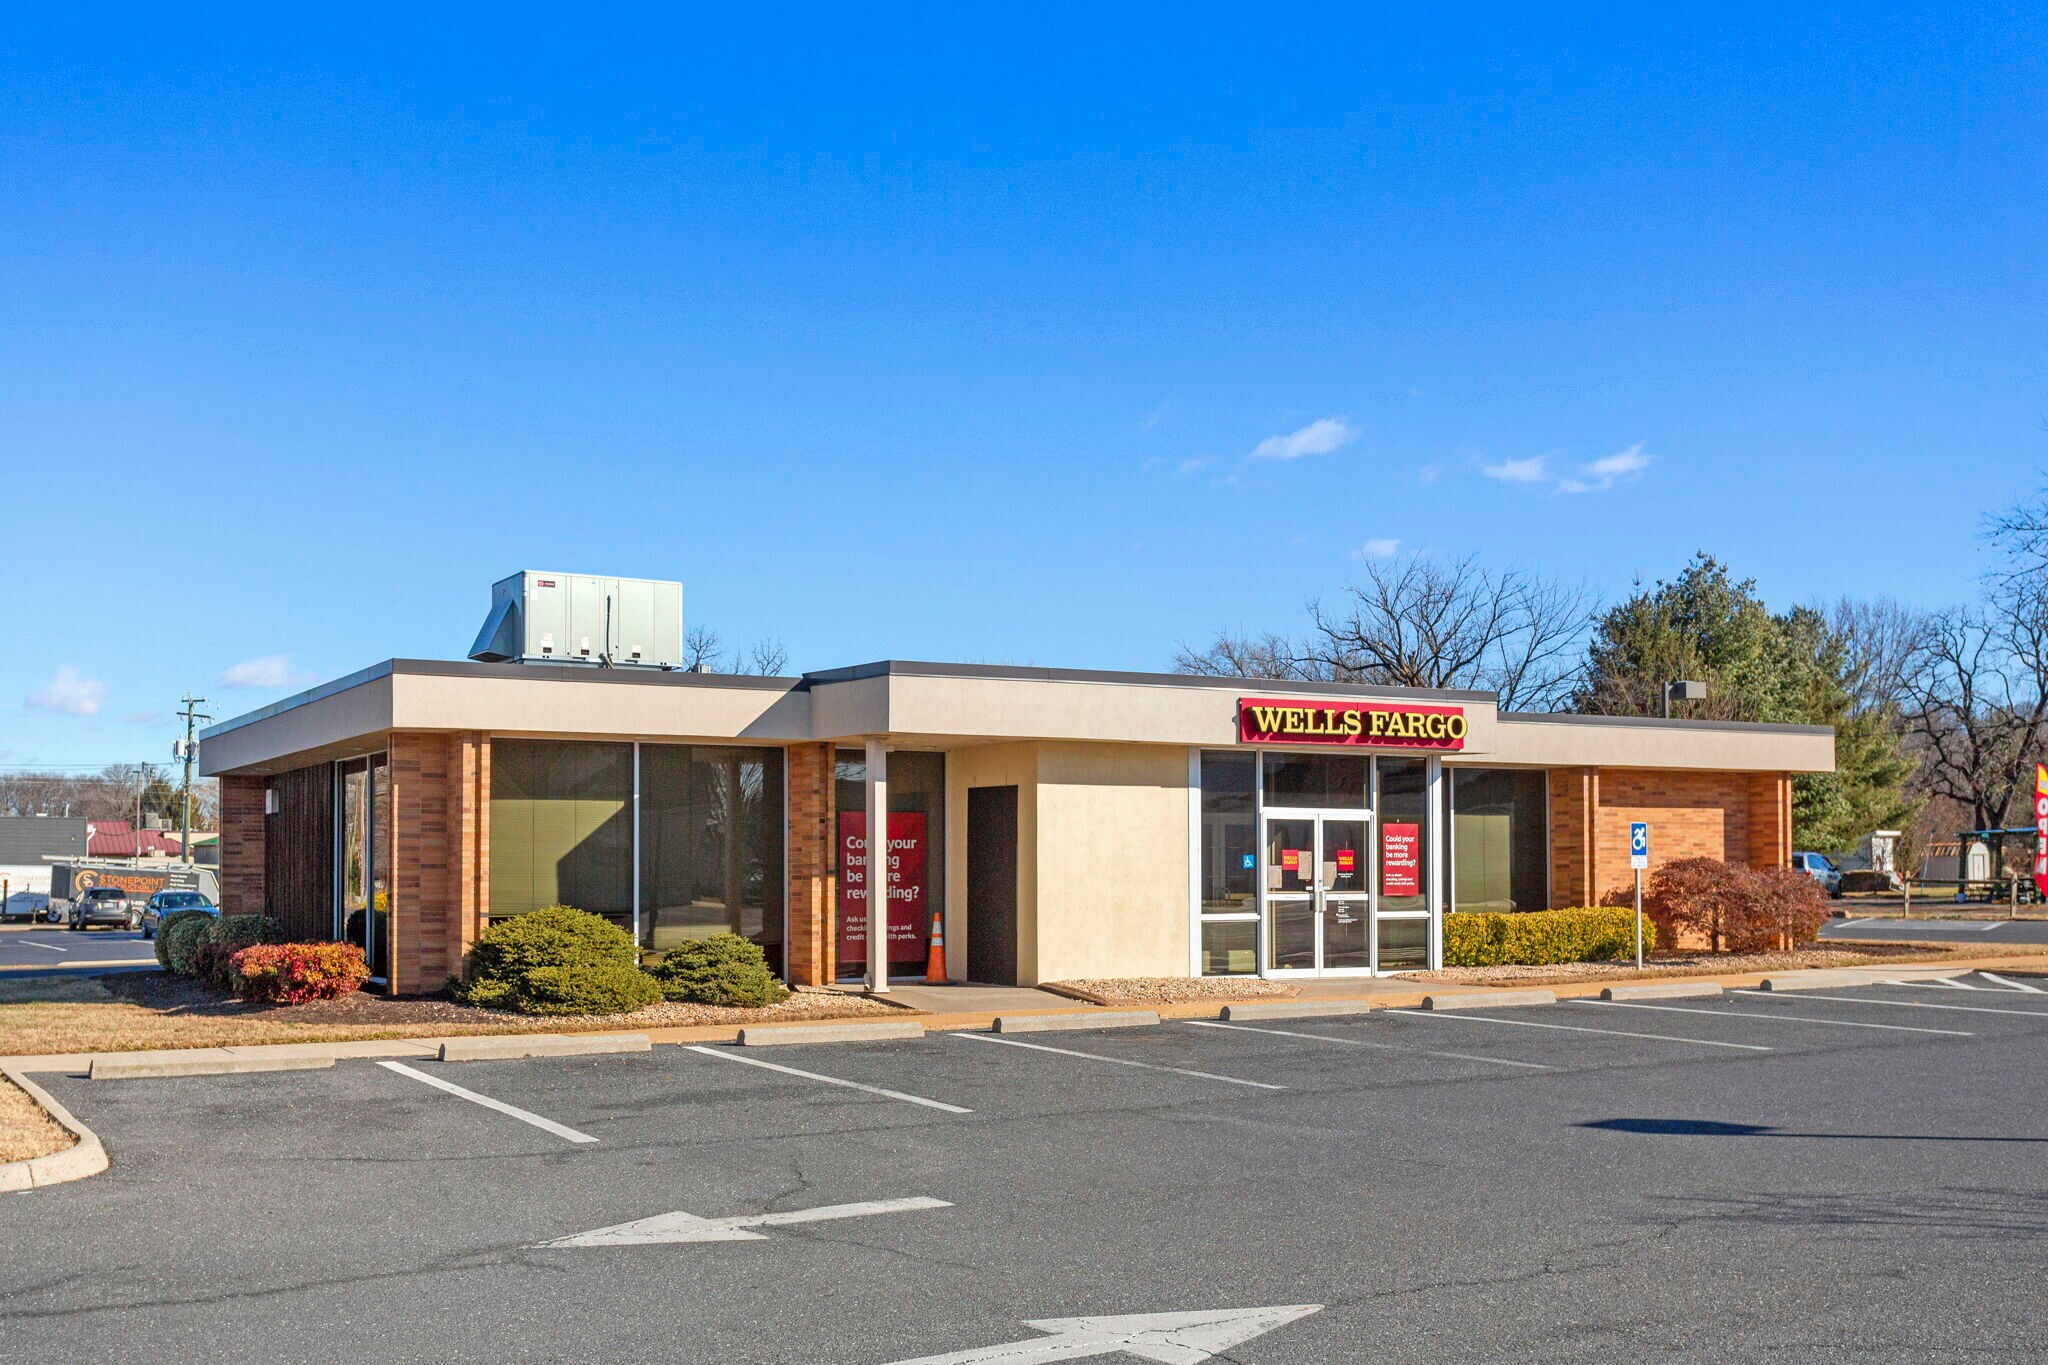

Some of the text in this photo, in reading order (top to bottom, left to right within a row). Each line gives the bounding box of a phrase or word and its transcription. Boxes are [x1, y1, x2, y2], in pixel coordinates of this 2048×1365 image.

[1252, 706, 1469, 739] WELLS FARGO
[887, 839, 917, 852] your
[1386, 843, 1408, 851] banking
[100, 875, 165, 886] STONEPOINT
[847, 869, 863, 882] be
[898, 933, 917, 941] perks.
